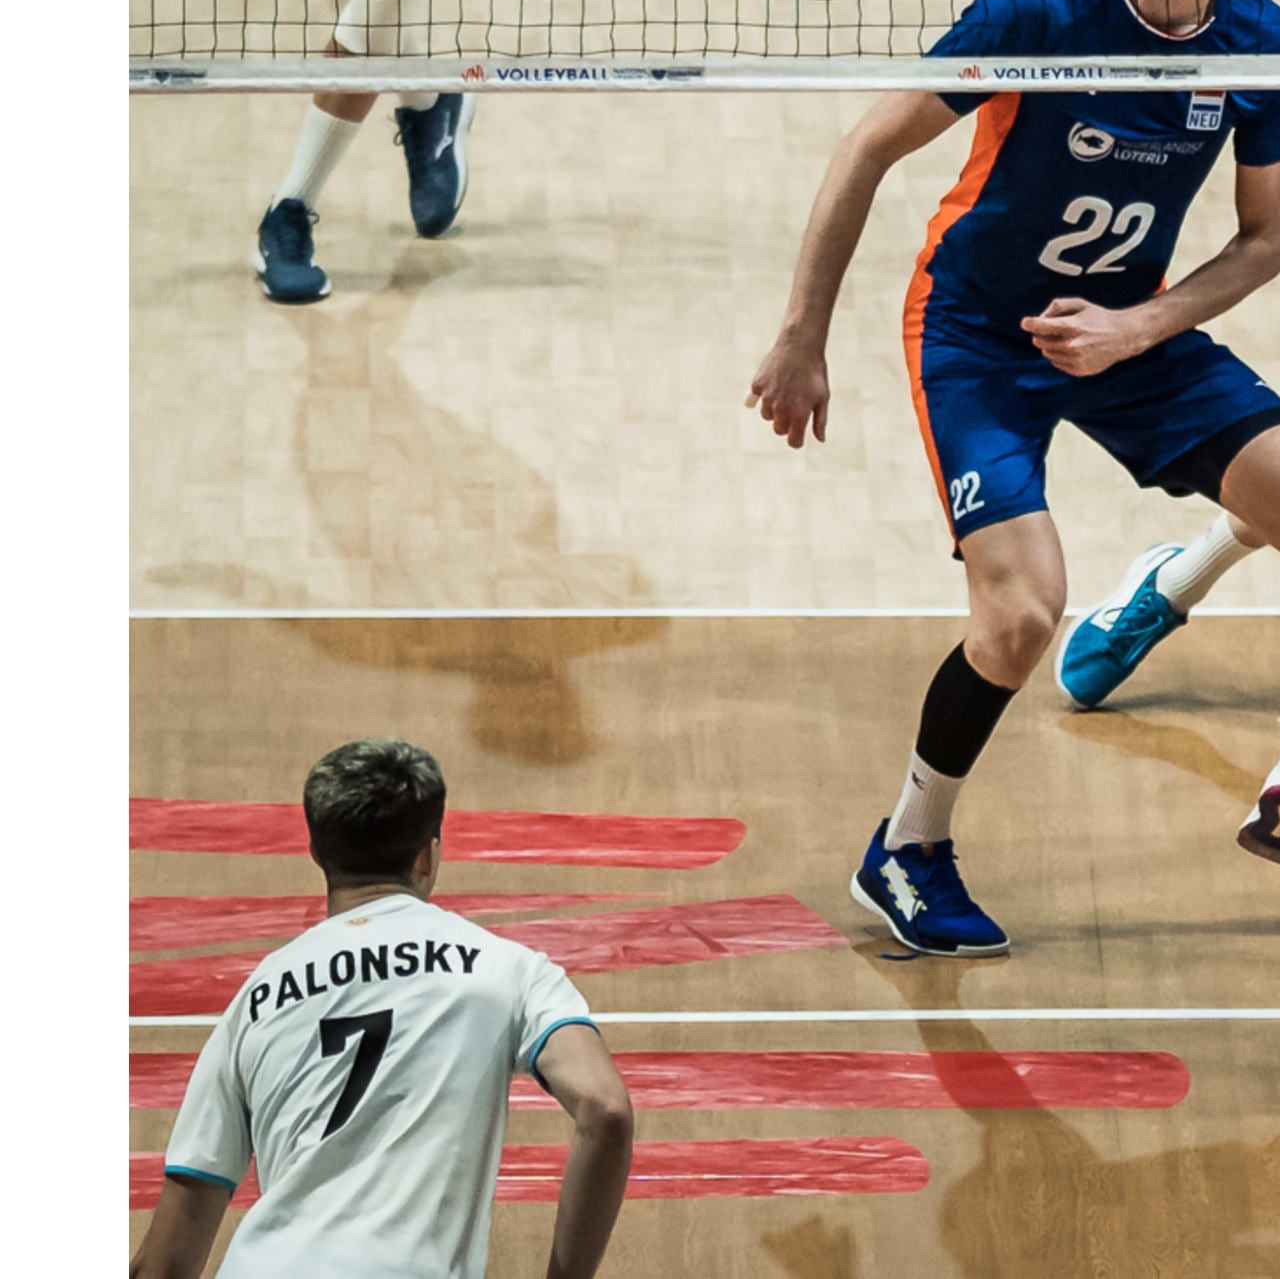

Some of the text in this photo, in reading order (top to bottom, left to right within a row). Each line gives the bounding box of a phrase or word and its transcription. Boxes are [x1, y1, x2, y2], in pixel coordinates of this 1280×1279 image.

[496, 67, 609, 81] VOLLEYBALL
[993, 66, 1104, 80] VOLLEYBALL
[1188, 111, 1220, 129] NED
[1038, 195, 1156, 277] 22
[950, 470, 986, 521] 22
[250, 939, 482, 1024] PALONSKY
[319, 1008, 395, 1142] 7
